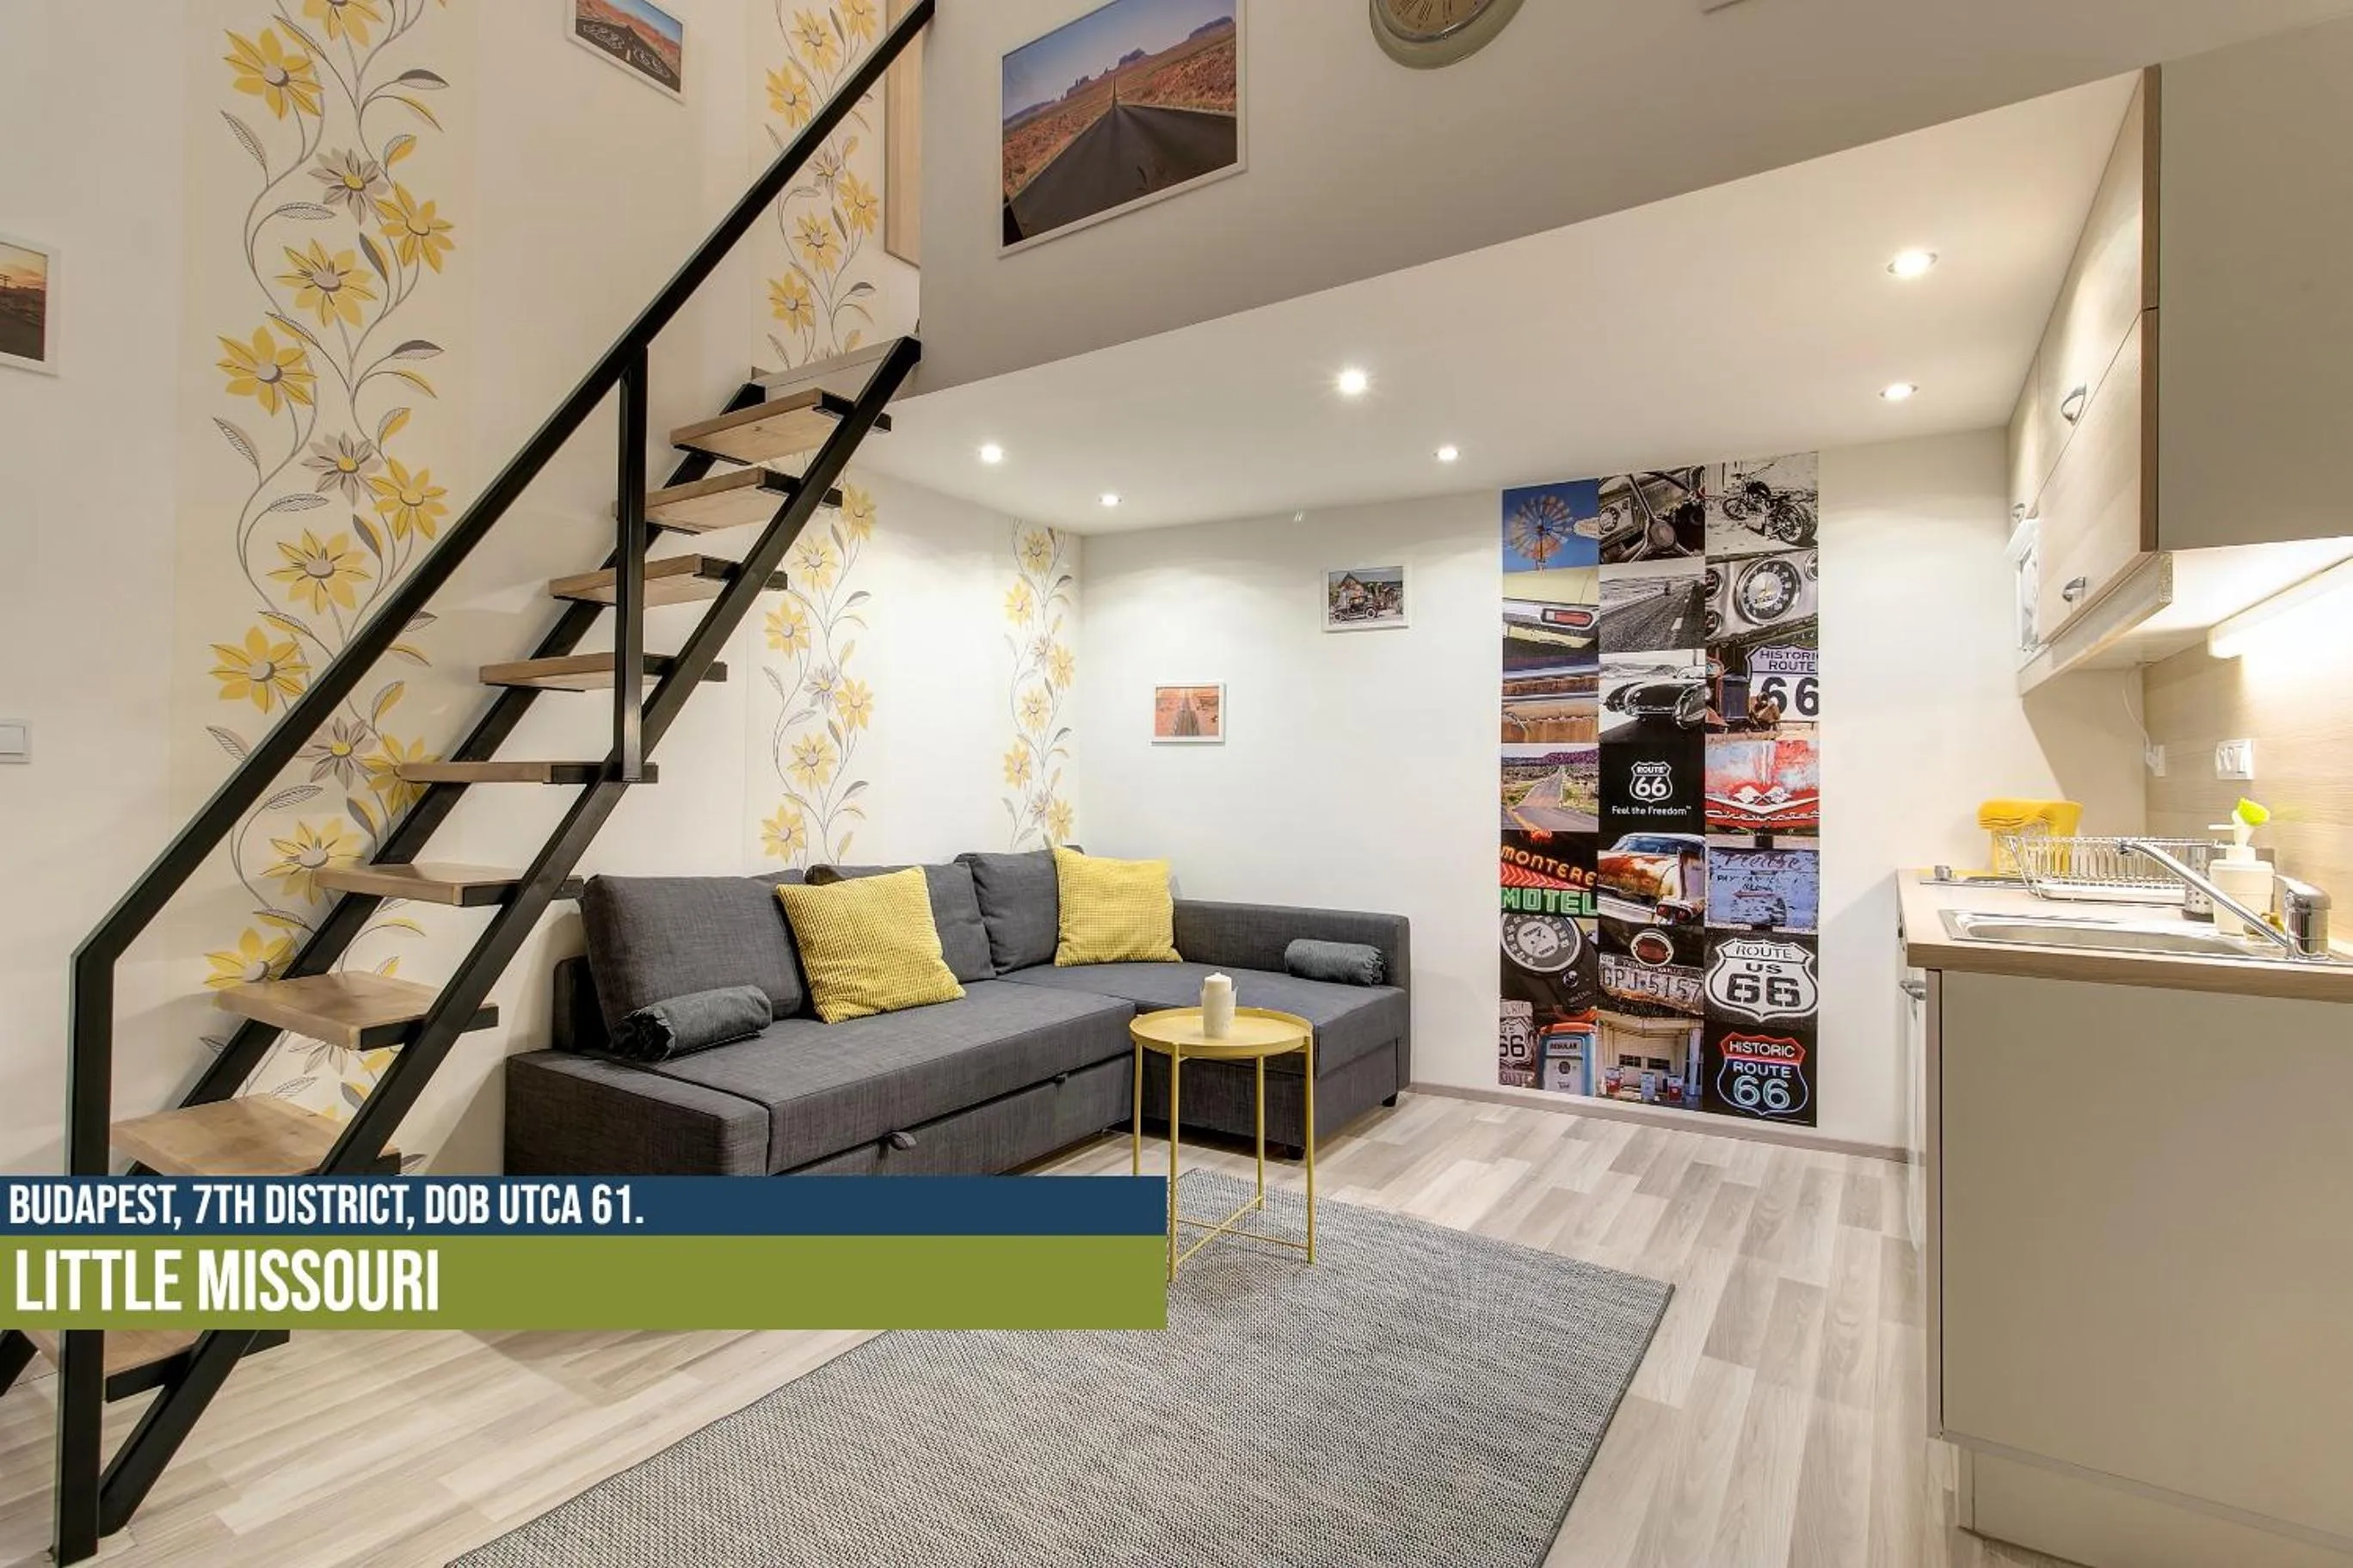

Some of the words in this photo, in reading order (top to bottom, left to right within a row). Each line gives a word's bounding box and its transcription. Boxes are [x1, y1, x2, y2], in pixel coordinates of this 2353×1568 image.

[1760, 650, 1819, 661] HISTORI
[1769, 661, 1815, 671] ROUTE
[1760, 677, 1819, 716] 66
[1635, 777, 1666, 797] 66
[1611, 805, 1630, 815] Feel
[1631, 806, 1646, 815] the
[1500, 887, 1598, 916] MOTEL
[1735, 945, 1792, 959] ROUTE
[1746, 962, 1783, 974] US
[1727, 973, 1801, 1007] 66
[1500, 1035, 1525, 1057] 66
[1729, 1041, 1796, 1058] HISTORIC
[1733, 1061, 1792, 1079] ROUTE
[1733, 1075, 1790, 1110] 66
